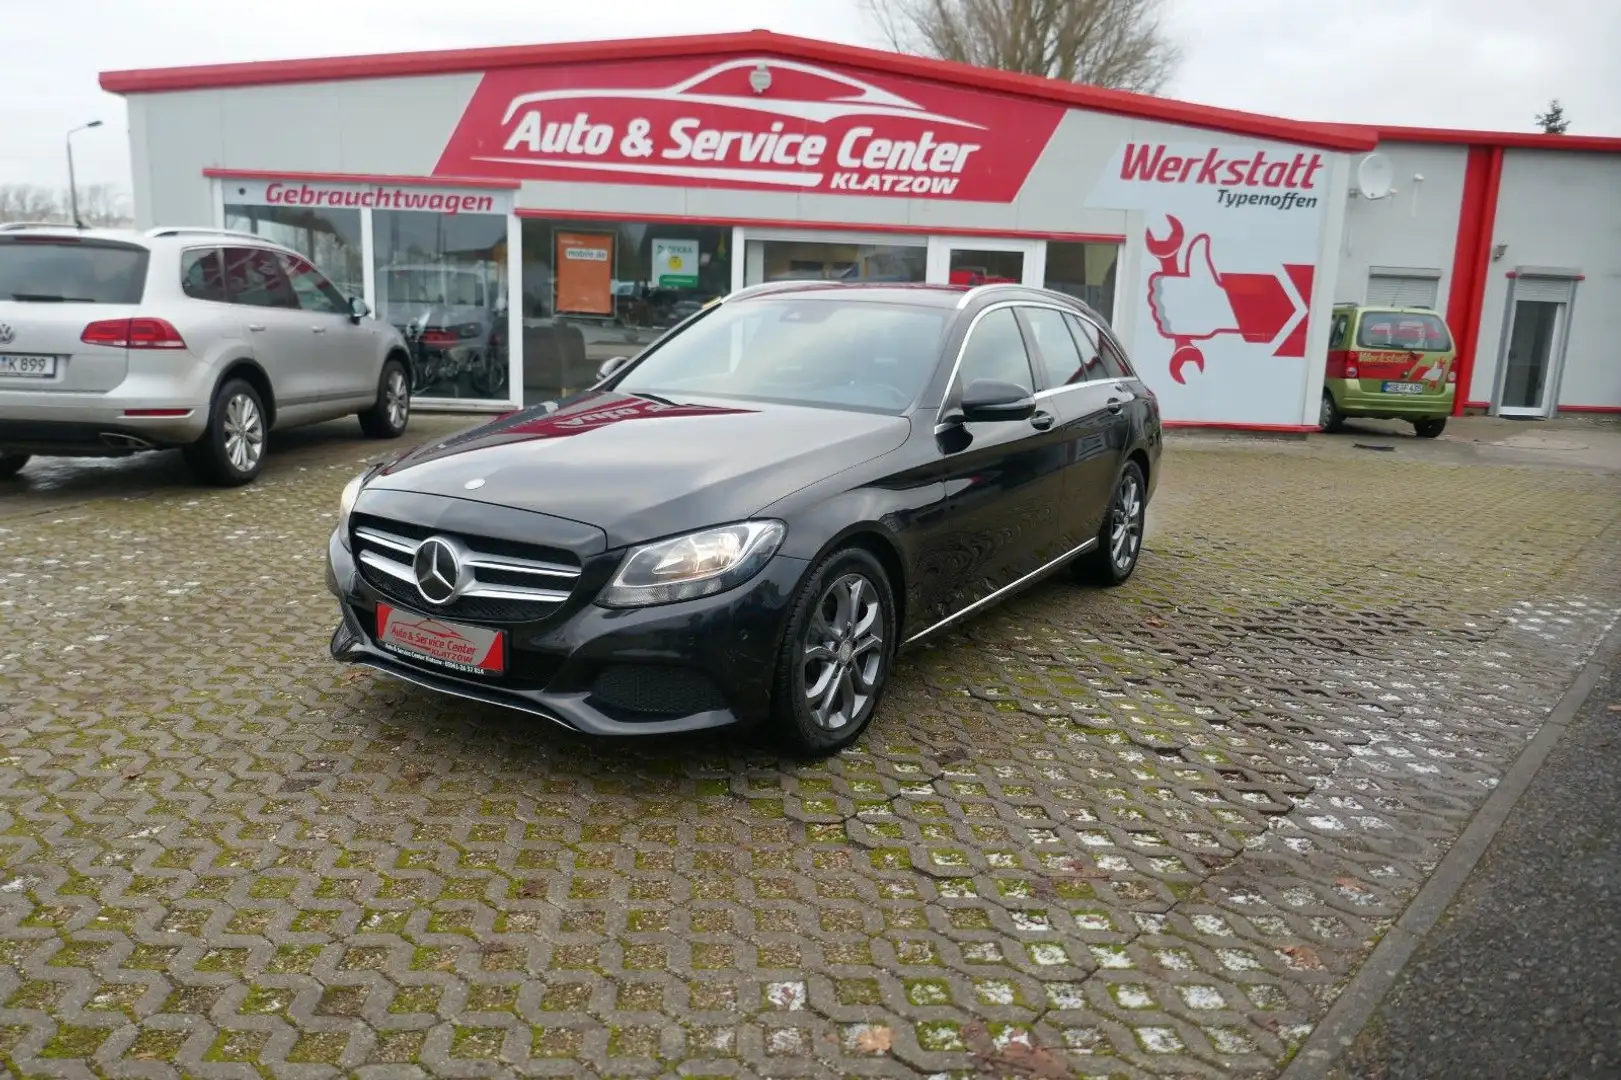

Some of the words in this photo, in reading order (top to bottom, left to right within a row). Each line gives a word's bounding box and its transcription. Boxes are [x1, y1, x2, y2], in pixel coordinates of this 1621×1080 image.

[503, 110, 614, 155] Auto
[620, 117, 653, 158] &
[661, 117, 827, 166] Service
[836, 126, 981, 174] Center
[1120, 143, 1323, 189] Werkstatt
[829, 172, 960, 195] KLATZOW
[265, 182, 494, 216] Gebrauchtwagen
[1217, 189, 1318, 211] Typenoffen
[568, 249, 606, 260] mobile.de
[20, 357, 47, 372] 899
[1359, 352, 1409, 364] Werkstatt
[390, 625, 408, 640] Auto
[408, 630, 415, 641] &
[416, 633, 446, 649] Service
[447, 641, 478, 656] Center
[430, 647, 474, 664] KLATZOW
